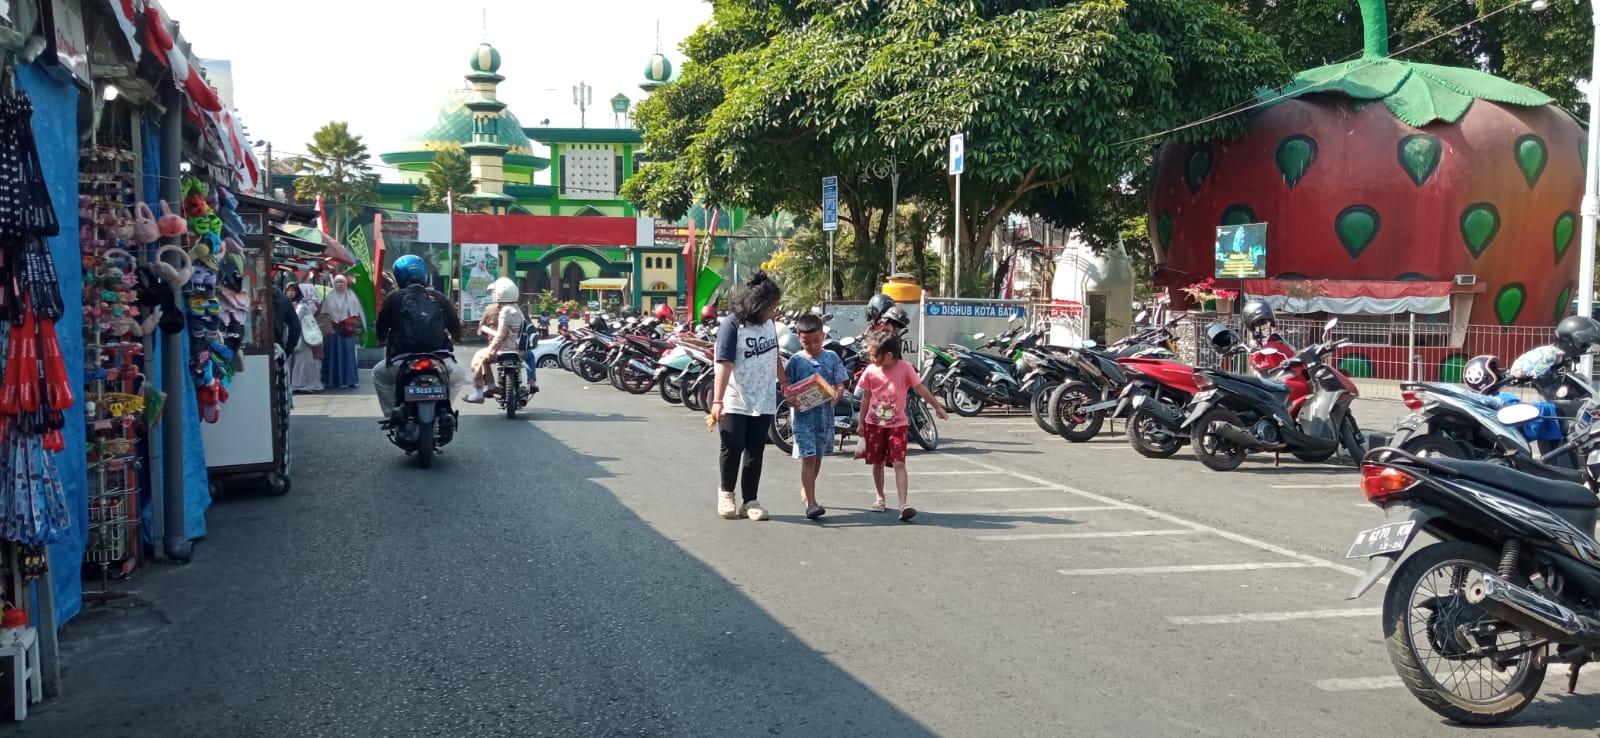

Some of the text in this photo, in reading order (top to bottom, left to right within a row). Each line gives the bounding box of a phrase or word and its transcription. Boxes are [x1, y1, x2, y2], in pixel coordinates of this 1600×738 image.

[951, 138, 962, 171] P
[942, 305, 1018, 317] DISHUB KOTA BATU
